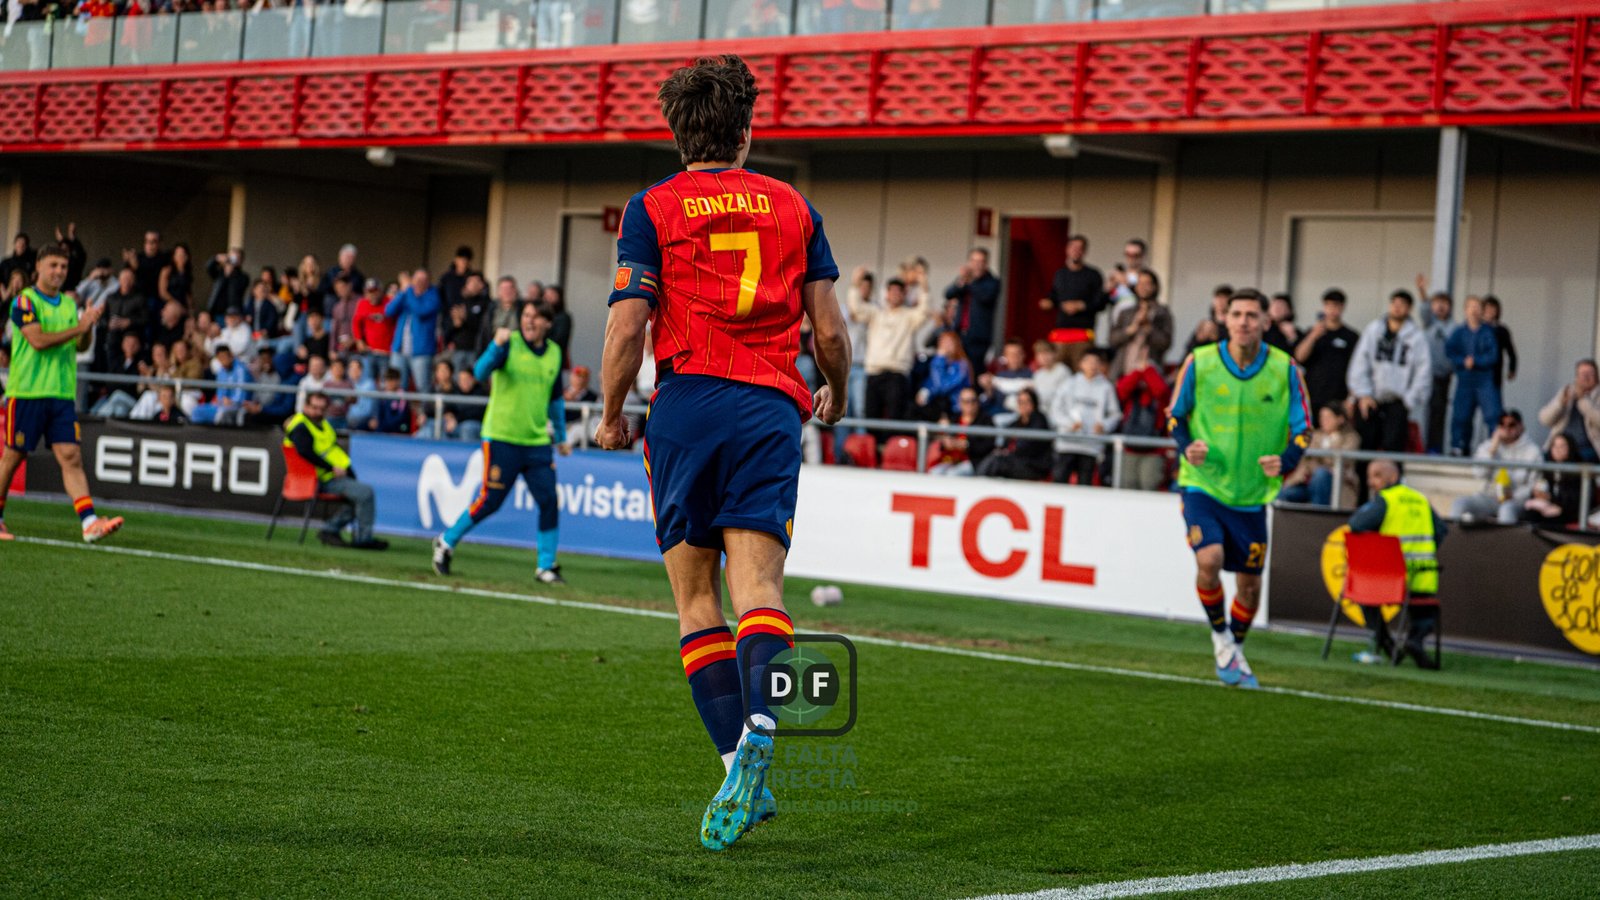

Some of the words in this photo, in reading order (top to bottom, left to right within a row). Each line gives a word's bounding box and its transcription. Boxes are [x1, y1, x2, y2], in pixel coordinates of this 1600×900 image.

[683, 193, 771, 218] GONZALO
[709, 231, 762, 319] 7
[94, 435, 270, 496] EBRO
[891, 493, 1096, 587] TCL
